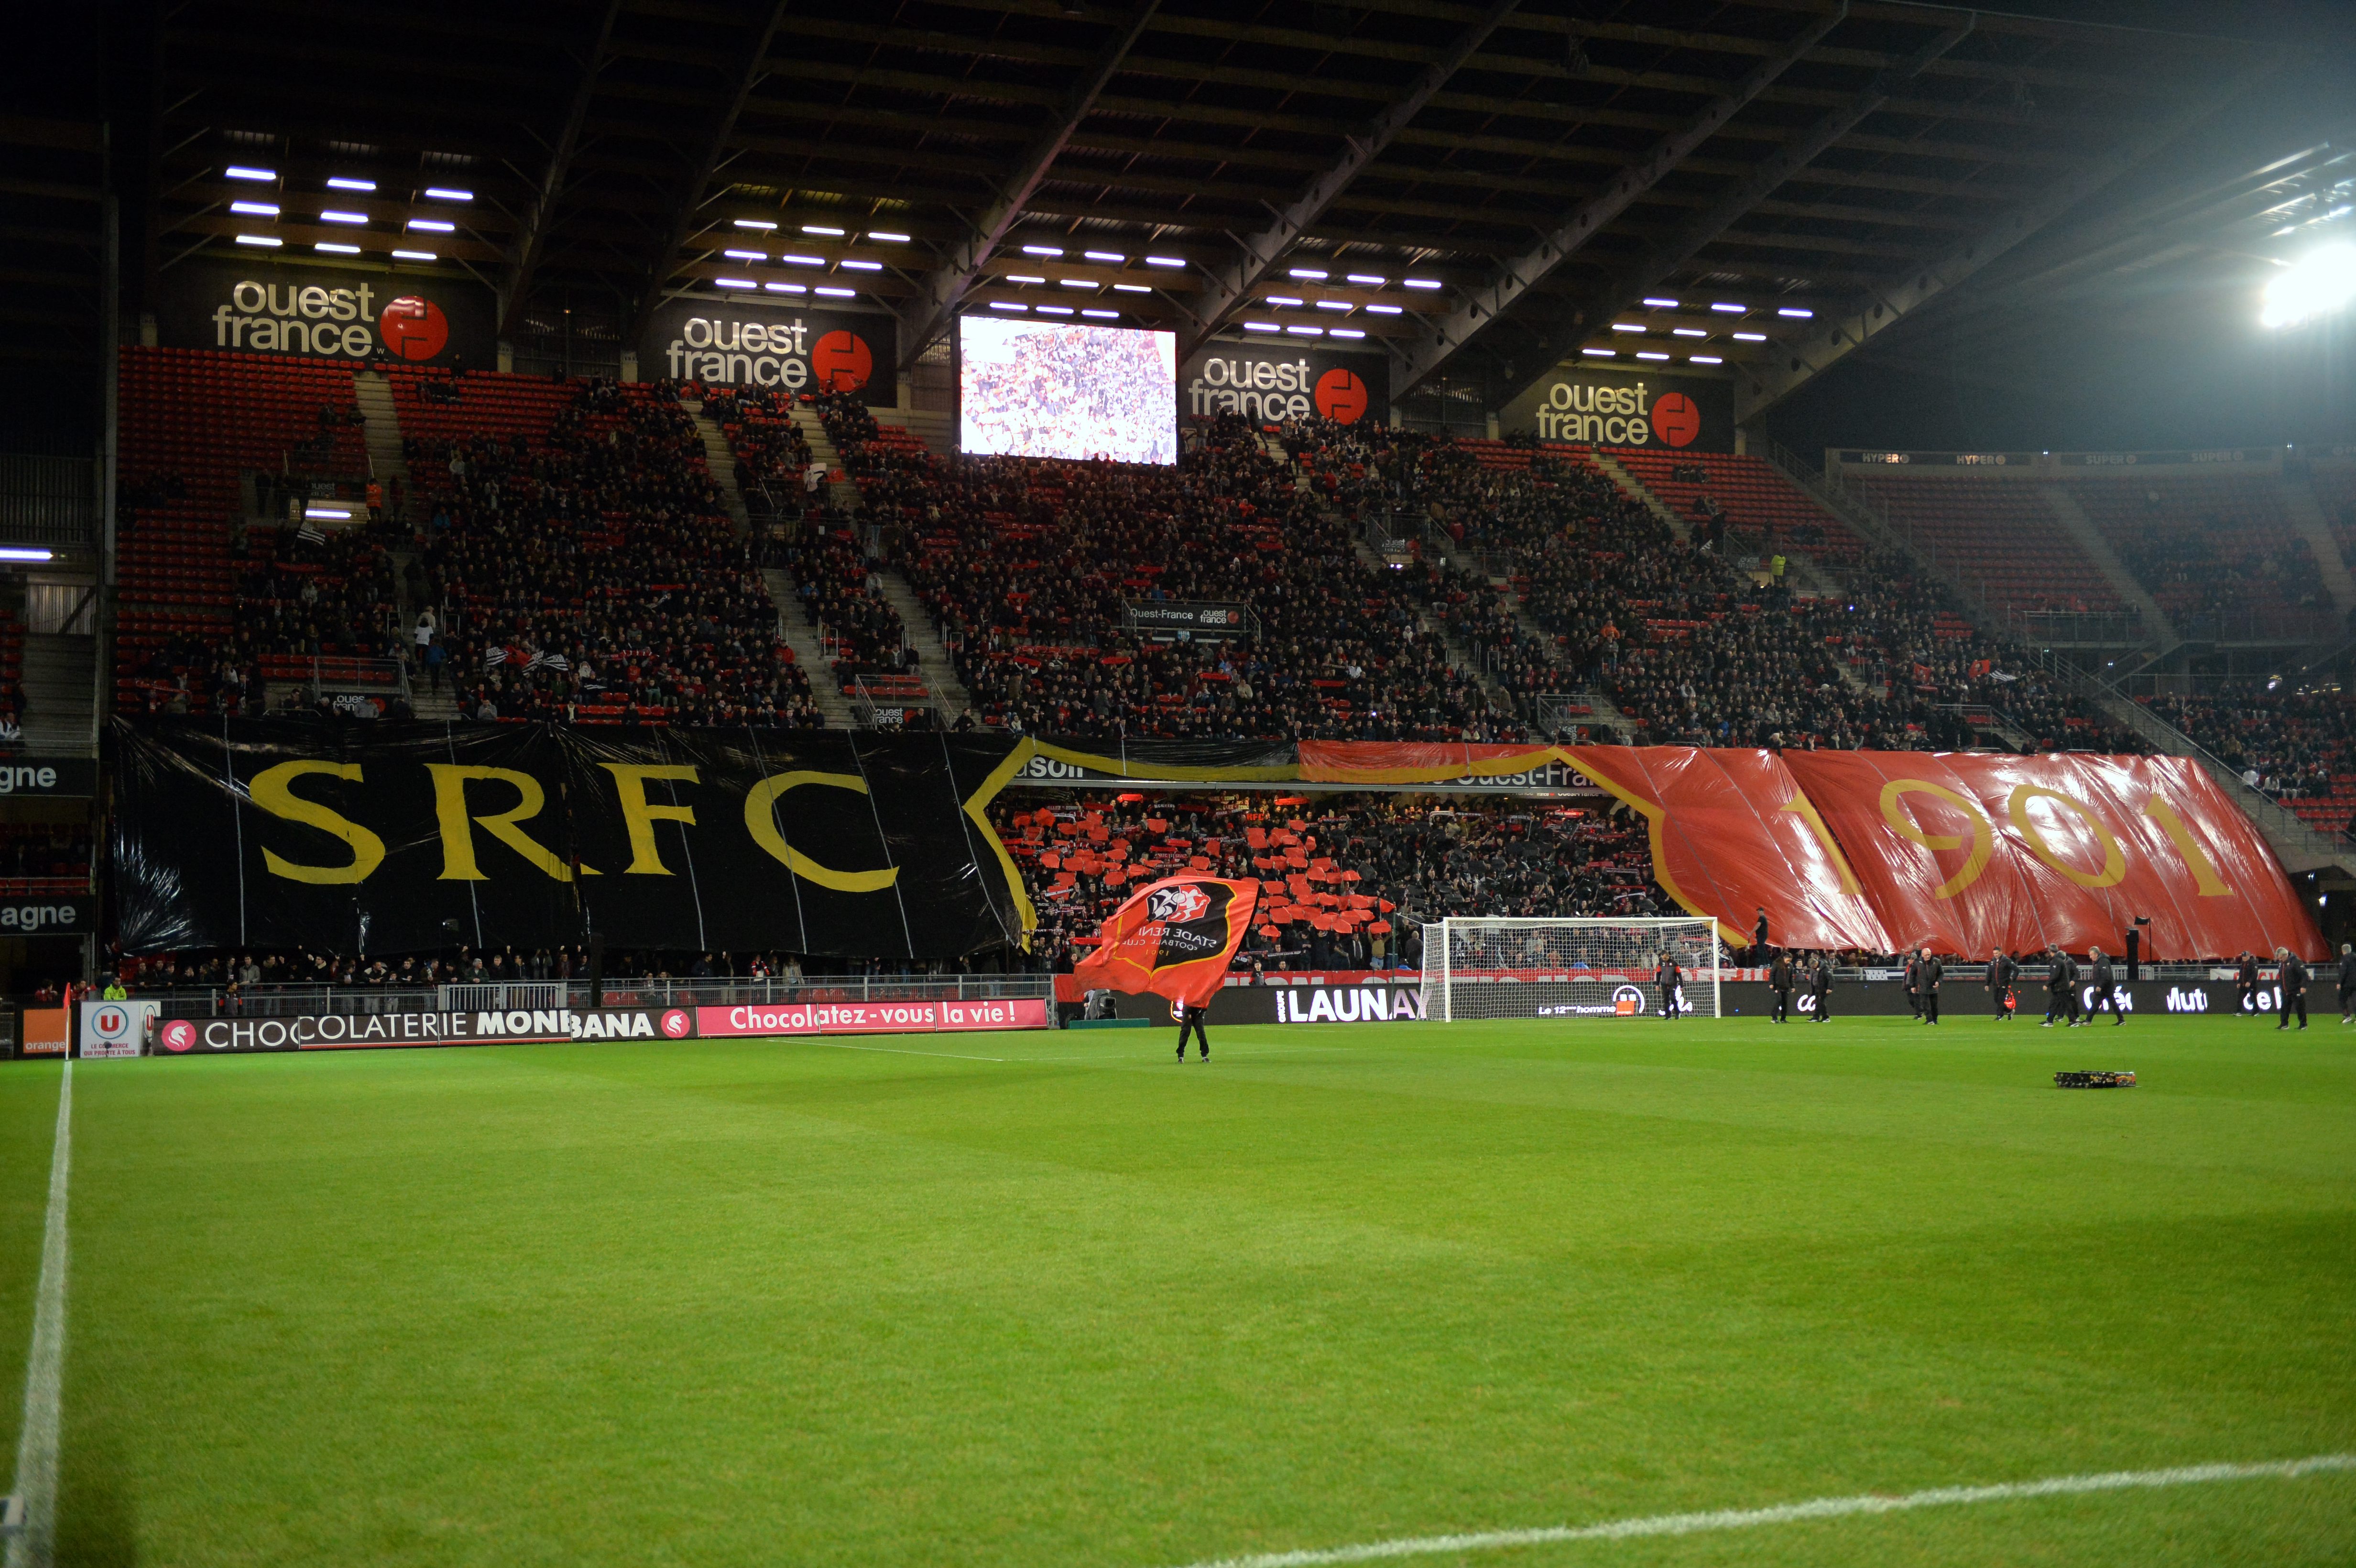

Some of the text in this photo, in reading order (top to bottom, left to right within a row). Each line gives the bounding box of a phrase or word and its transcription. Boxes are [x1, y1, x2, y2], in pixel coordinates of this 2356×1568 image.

[233, 281, 374, 322] ouest
[212, 305, 372, 357] france
[684, 317, 807, 356] ouest
[666, 339, 807, 388] france
[1204, 358, 1310, 393] ouest
[1188, 379, 1310, 422] france
[1550, 382, 1648, 415] ouest
[1536, 404, 1648, 445] france
[1863, 453, 1899, 463] HYPER
[1956, 455, 1994, 465] HYPER
[2086, 455, 2124, 465] SUPER
[2192, 452, 2232, 462] SUPER
[1130, 608, 1193, 620] Ouest-France
[1200, 615, 1227, 624] france
[332, 700, 355, 711] fran
[337, 695, 365, 704] oues
[249, 760, 900, 893] SRFC
[1780, 779, 2236, 900] 1901
[1, 906, 76, 931] agne
[731, 1005, 934, 1029] Chocolatez-vous
[943, 1002, 964, 1023] la
[1538, 1006, 1552, 1014] Le
[1577, 1005, 1616, 1013] homme
[101, 1015, 119, 1032] U
[206, 1010, 655, 1048] CHOCOLATERIE MONBANA
[25, 1041, 66, 1052] orange
